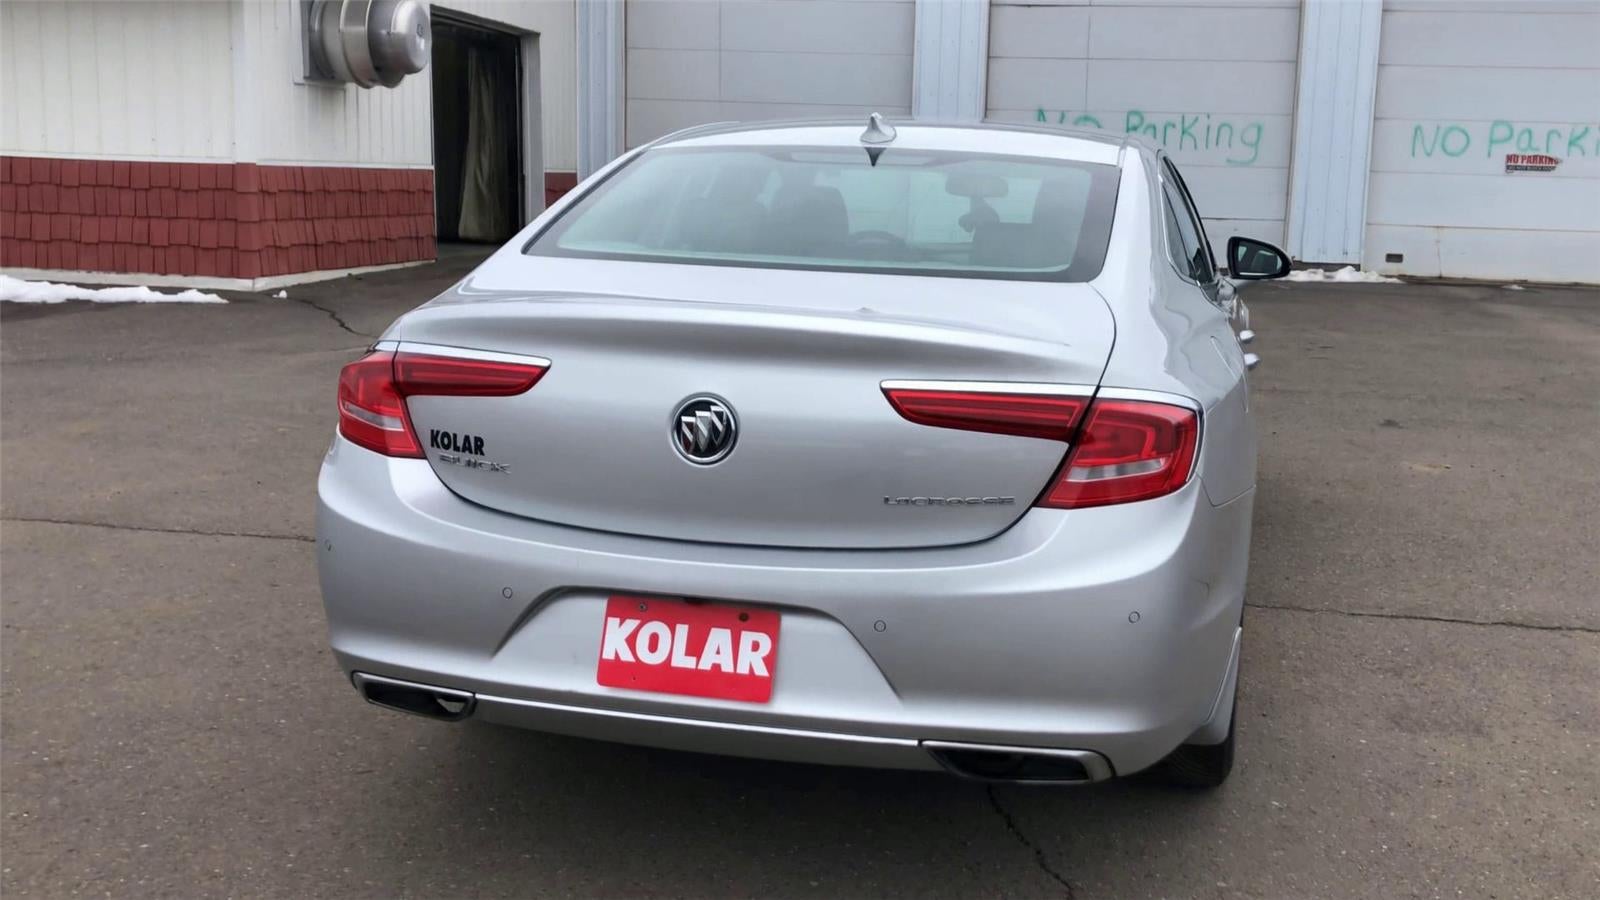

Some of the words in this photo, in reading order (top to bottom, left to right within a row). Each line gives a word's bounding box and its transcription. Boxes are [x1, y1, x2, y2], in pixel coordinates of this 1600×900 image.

[1411, 124, 1471, 158] NO
[1506, 154, 1519, 164] NO
[430, 428, 485, 456] KOLAR
[602, 616, 772, 677] KOLAR
